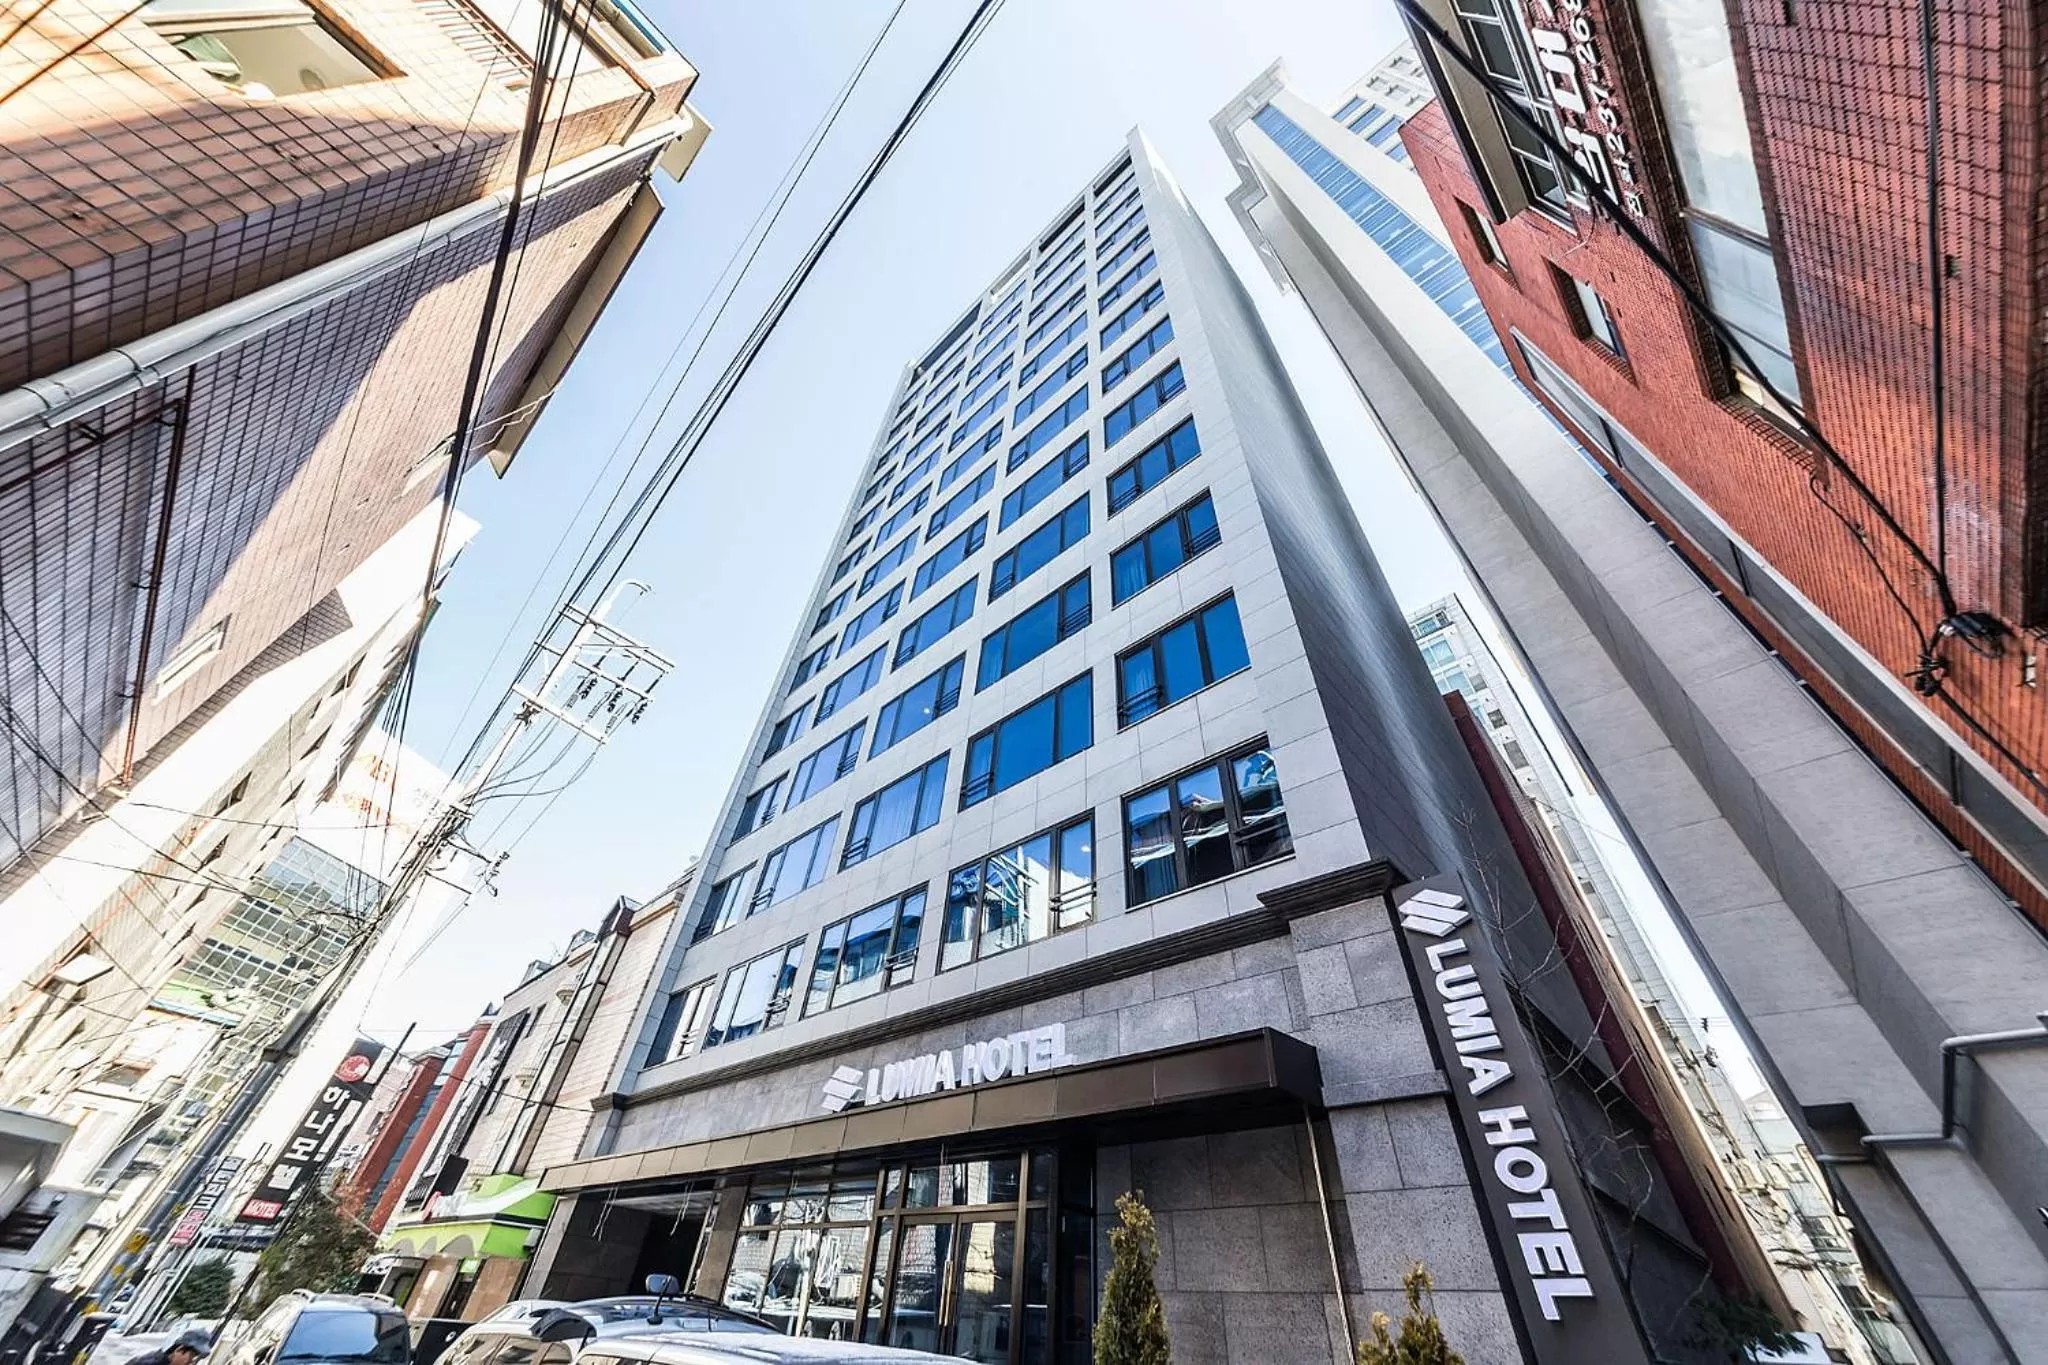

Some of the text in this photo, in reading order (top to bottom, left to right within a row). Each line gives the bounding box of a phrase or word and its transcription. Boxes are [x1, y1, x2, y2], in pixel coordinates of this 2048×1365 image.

[865, 1023, 1078, 1106] LUMIA HOTEL
[1426, 938, 1595, 1321] LUMIA HOTEL
[243, 1200, 282, 1218] MOTEL
